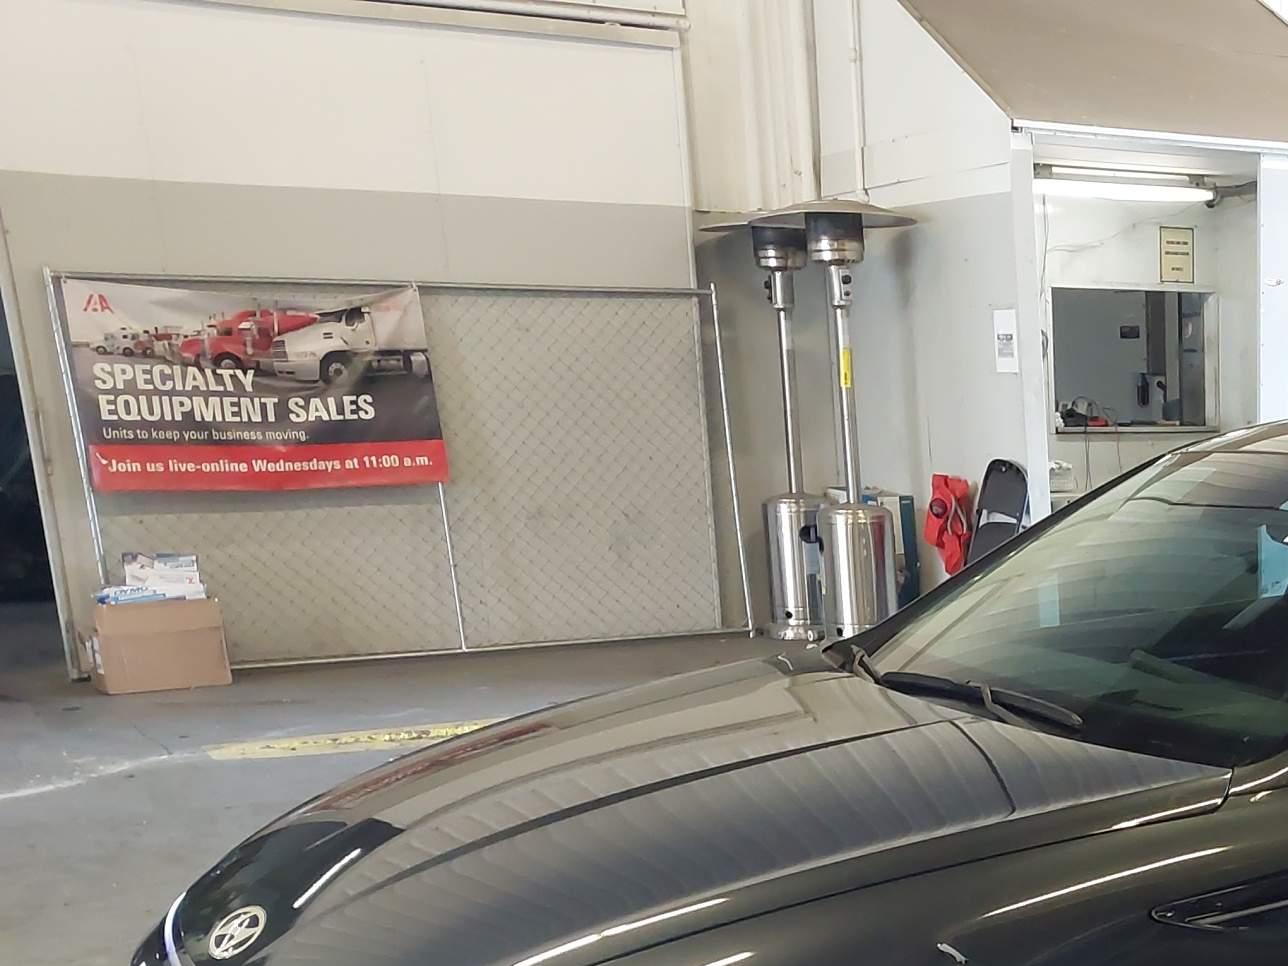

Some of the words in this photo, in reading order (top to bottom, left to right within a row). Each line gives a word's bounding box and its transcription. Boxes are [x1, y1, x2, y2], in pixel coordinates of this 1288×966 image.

[92, 362, 255, 393] SPECIALTY
[97, 394, 279, 423] EQUIPMENT
[287, 394, 376, 423] SALES
[102, 426, 135, 440] Units
[136, 428, 149, 440] to
[151, 427, 180, 442] keep
[182, 430, 209, 442] your
[211, 428, 263, 441] business
[265, 429, 310, 442] moving.
[108, 459, 142, 473] Join
[146, 463, 165, 473] us
[168, 459, 248, 473] live-online
[252, 458, 341, 473] Wednesdays
[345, 457, 360, 469] at
[363, 455, 400, 469] 11:00
[403, 456, 433, 467] a.m.
